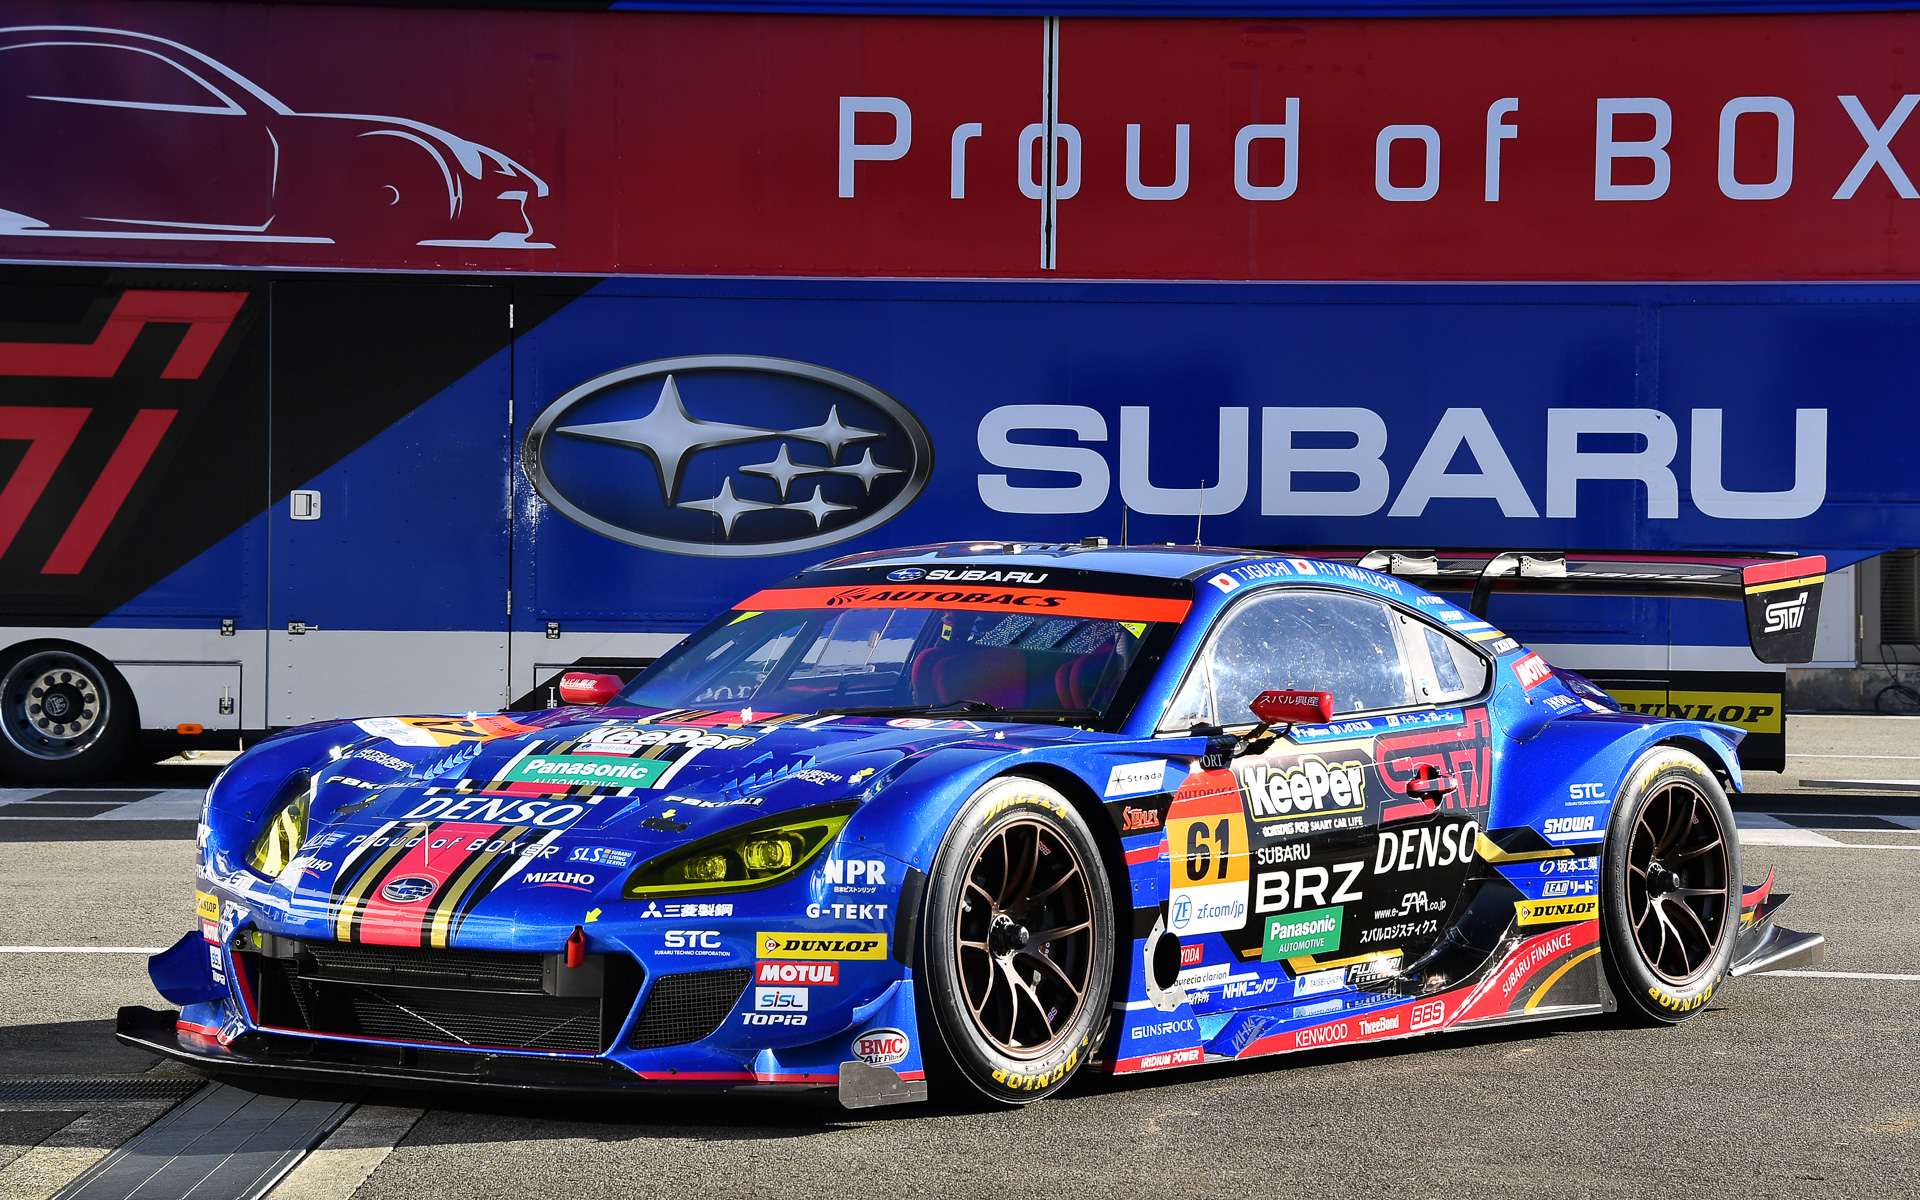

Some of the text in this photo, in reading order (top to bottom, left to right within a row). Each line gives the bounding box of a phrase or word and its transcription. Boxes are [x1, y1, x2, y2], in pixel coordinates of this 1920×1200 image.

[838, 96, 1300, 202] Proud
[1375, 96, 1519, 202] of
[977, 404, 1828, 520] SUBARU
[926, 569, 1049, 585] SUBARU
[1231, 561, 1403, 596] T.IGUCHI H.YAMAUCHI
[864, 590, 1067, 607] AUTOBACS
[1515, 655, 1552, 687] MOTUL
[1260, 695, 1320, 707] スバル興産
[577, 725, 756, 751] KeePer
[521, 758, 649, 780] Panasonic
[797, 769, 843, 783] UBISHI
[1127, 772, 1163, 783] Strada
[1178, 786, 1235, 801] AUTOBACS
[1243, 758, 1365, 817] KeePer
[1569, 782, 1606, 799] STC
[401, 796, 584, 826] DENSO
[1310, 819, 1333, 831] SMART
[1333, 817, 1348, 829] CAR
[1348, 816, 1364, 827] LIFE
[1543, 815, 1595, 834] SHOWA
[345, 833, 425, 849] Proud
[430, 836, 464, 850] of
[465, 837, 560, 859] BOXER
[569, 847, 604, 862] SLS
[1186, 818, 1230, 882] 61
[1256, 843, 1311, 866] SUBARU
[1373, 821, 1480, 875] DENSO
[825, 859, 886, 885] NPR
[1556, 856, 1598, 872] 坂本工業
[522, 872, 595, 885] MIZUHO
[1254, 861, 1365, 914] BRZ
[1545, 879, 1594, 896] LEAD リード
[664, 903, 733, 918] 三菱製鋼
[806, 903, 888, 920] G-TEKT
[1174, 899, 1190, 921] ZF
[1196, 899, 1245, 920] zf.com/jp
[1532, 902, 1596, 917] DUNLOP
[1270, 913, 1336, 941] Panasonic
[1359, 919, 1437, 944] スバルロジスティクス
[664, 930, 722, 948] STC
[782, 939, 879, 953] DUNLOP
[1278, 937, 1326, 955] AUTOMOTIVE
[1181, 946, 1200, 963] YODA
[759, 964, 836, 983] MOTUL
[1502, 932, 1572, 999] SUBARU FINANCE
[1174, 971, 1227, 988] aurecia clarion
[1648, 983, 1714, 1013] DUNLOP
[741, 1012, 808, 1026] Topia
[1359, 1013, 1400, 1036] ThreeBond
[1410, 999, 1446, 1031] BBS
[1131, 1018, 1195, 1040] GUNSROCK
[1295, 1023, 1349, 1048] KENWOOD
[859, 1037, 904, 1055] BMC
[863, 1054, 882, 1064] Air
[991, 1046, 1079, 1091] DUNLOP
[1141, 1051, 1200, 1069] IRIDIUM POWER
